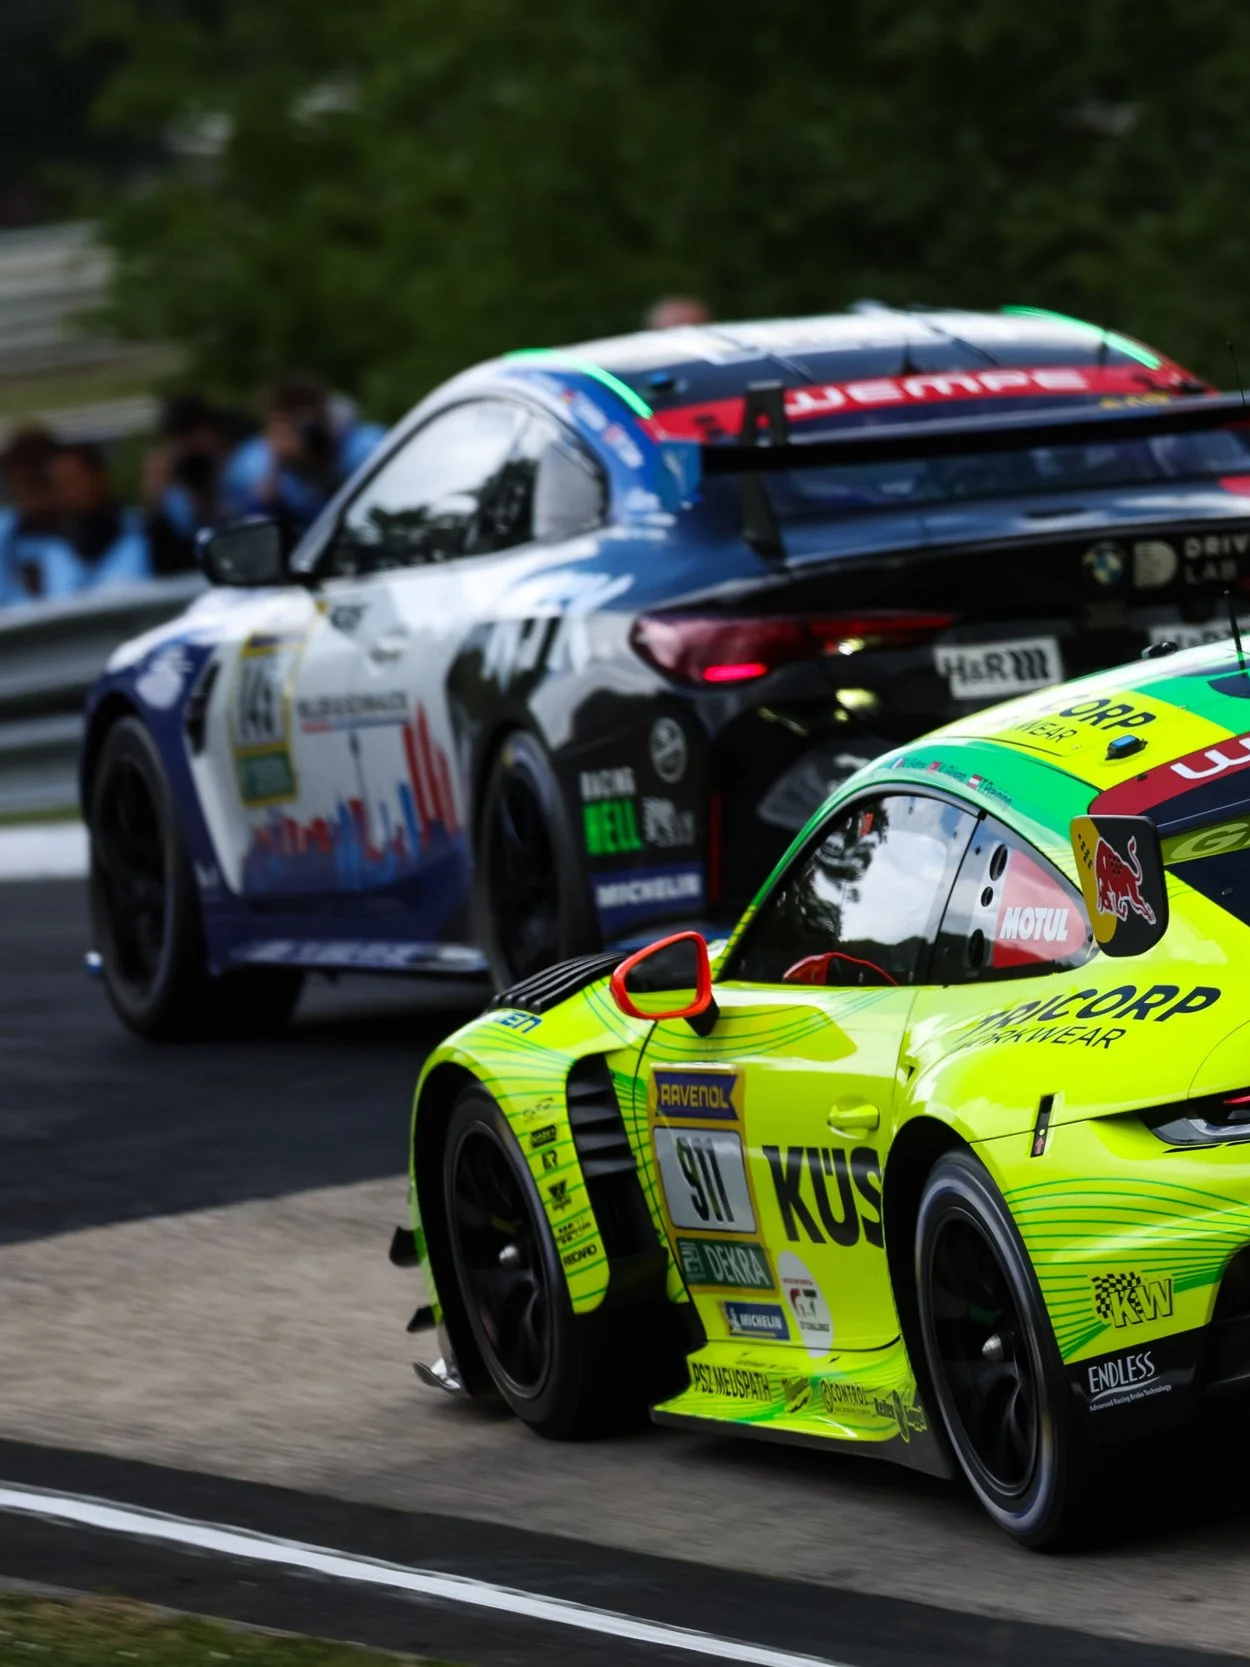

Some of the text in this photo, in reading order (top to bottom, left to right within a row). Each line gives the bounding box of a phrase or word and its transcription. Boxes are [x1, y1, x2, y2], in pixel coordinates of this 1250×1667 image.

[1185, 559, 1237, 584] LAB
[596, 873, 701, 908] MICHELIN
[1000, 907, 1069, 941] MOTUL
[661, 1084, 729, 1109] RAVENOL
[676, 1137, 735, 1222] 911
[703, 1244, 770, 1285] DEKRA
[1110, 1278, 1173, 1328] KW
[739, 1313, 783, 1330] MICHELIN
[1088, 1351, 1155, 1393] ENDLESS
